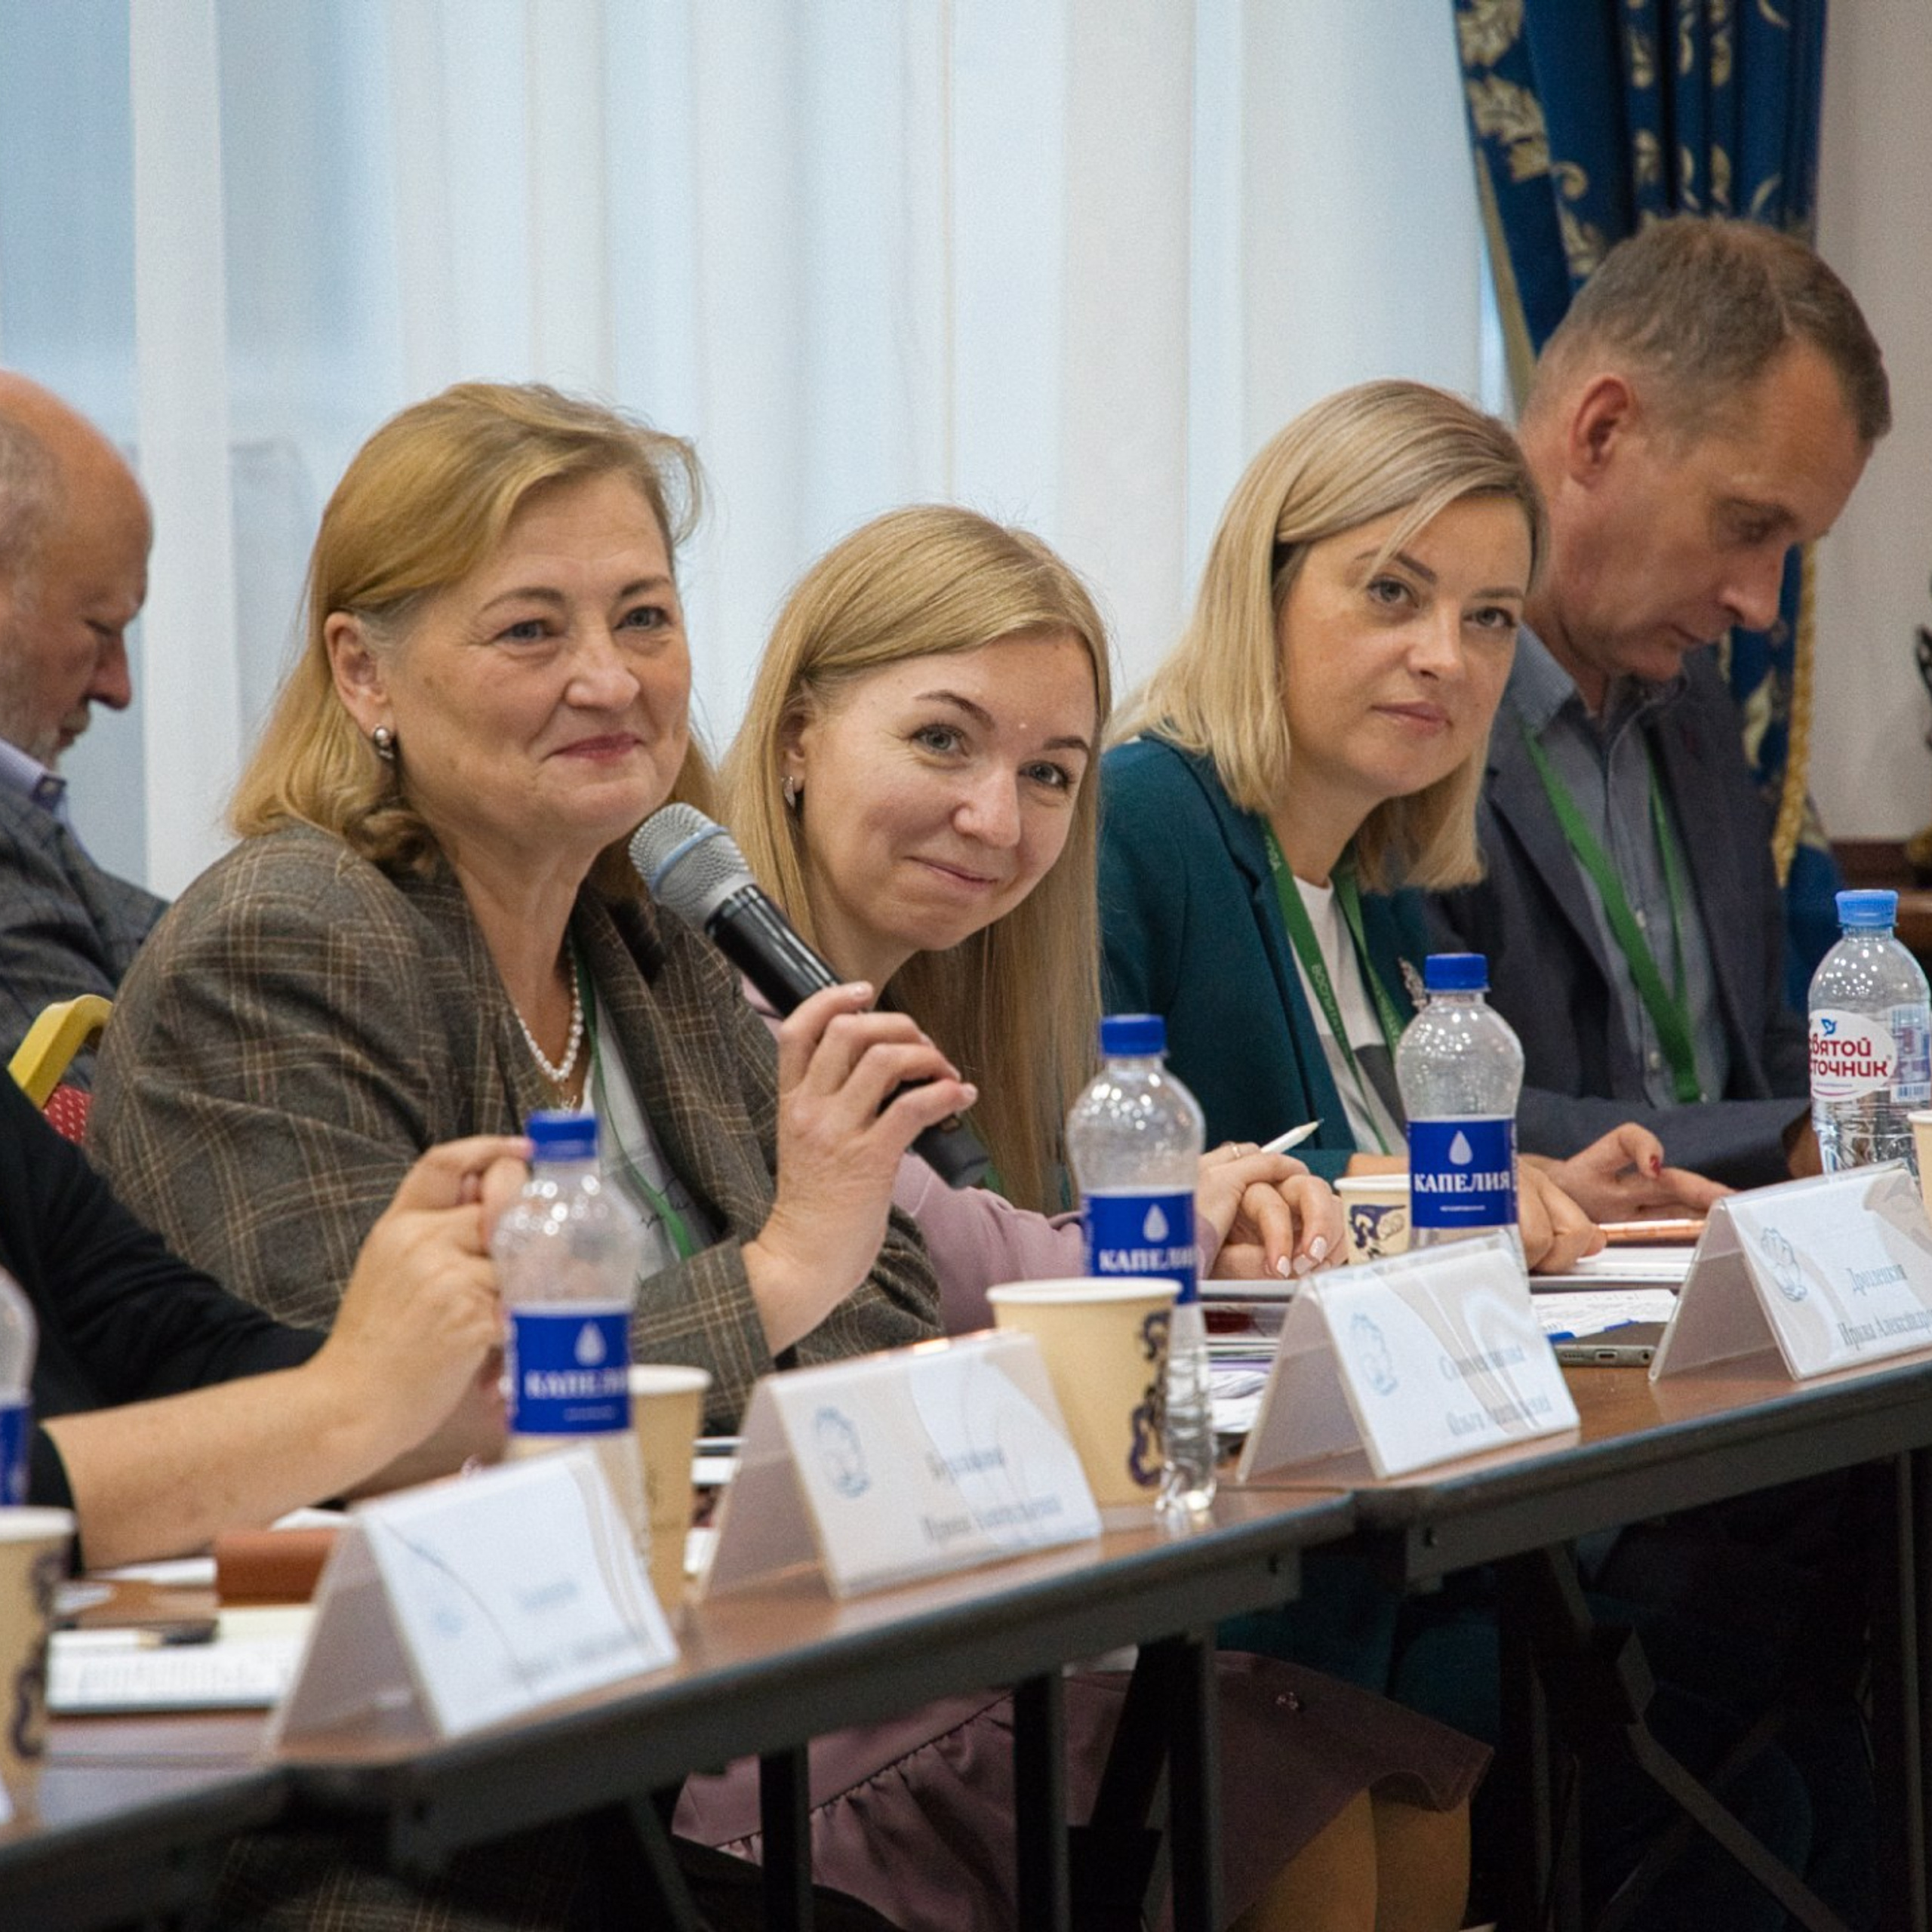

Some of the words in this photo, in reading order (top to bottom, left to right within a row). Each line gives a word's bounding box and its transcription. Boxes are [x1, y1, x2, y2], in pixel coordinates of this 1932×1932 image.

[1808, 1032, 1871, 1057] ВЯТОЙ
[1809, 1059, 1888, 1077] ТОЧНИК
[1414, 1171, 1510, 1193] КАПЕЛИЯ
